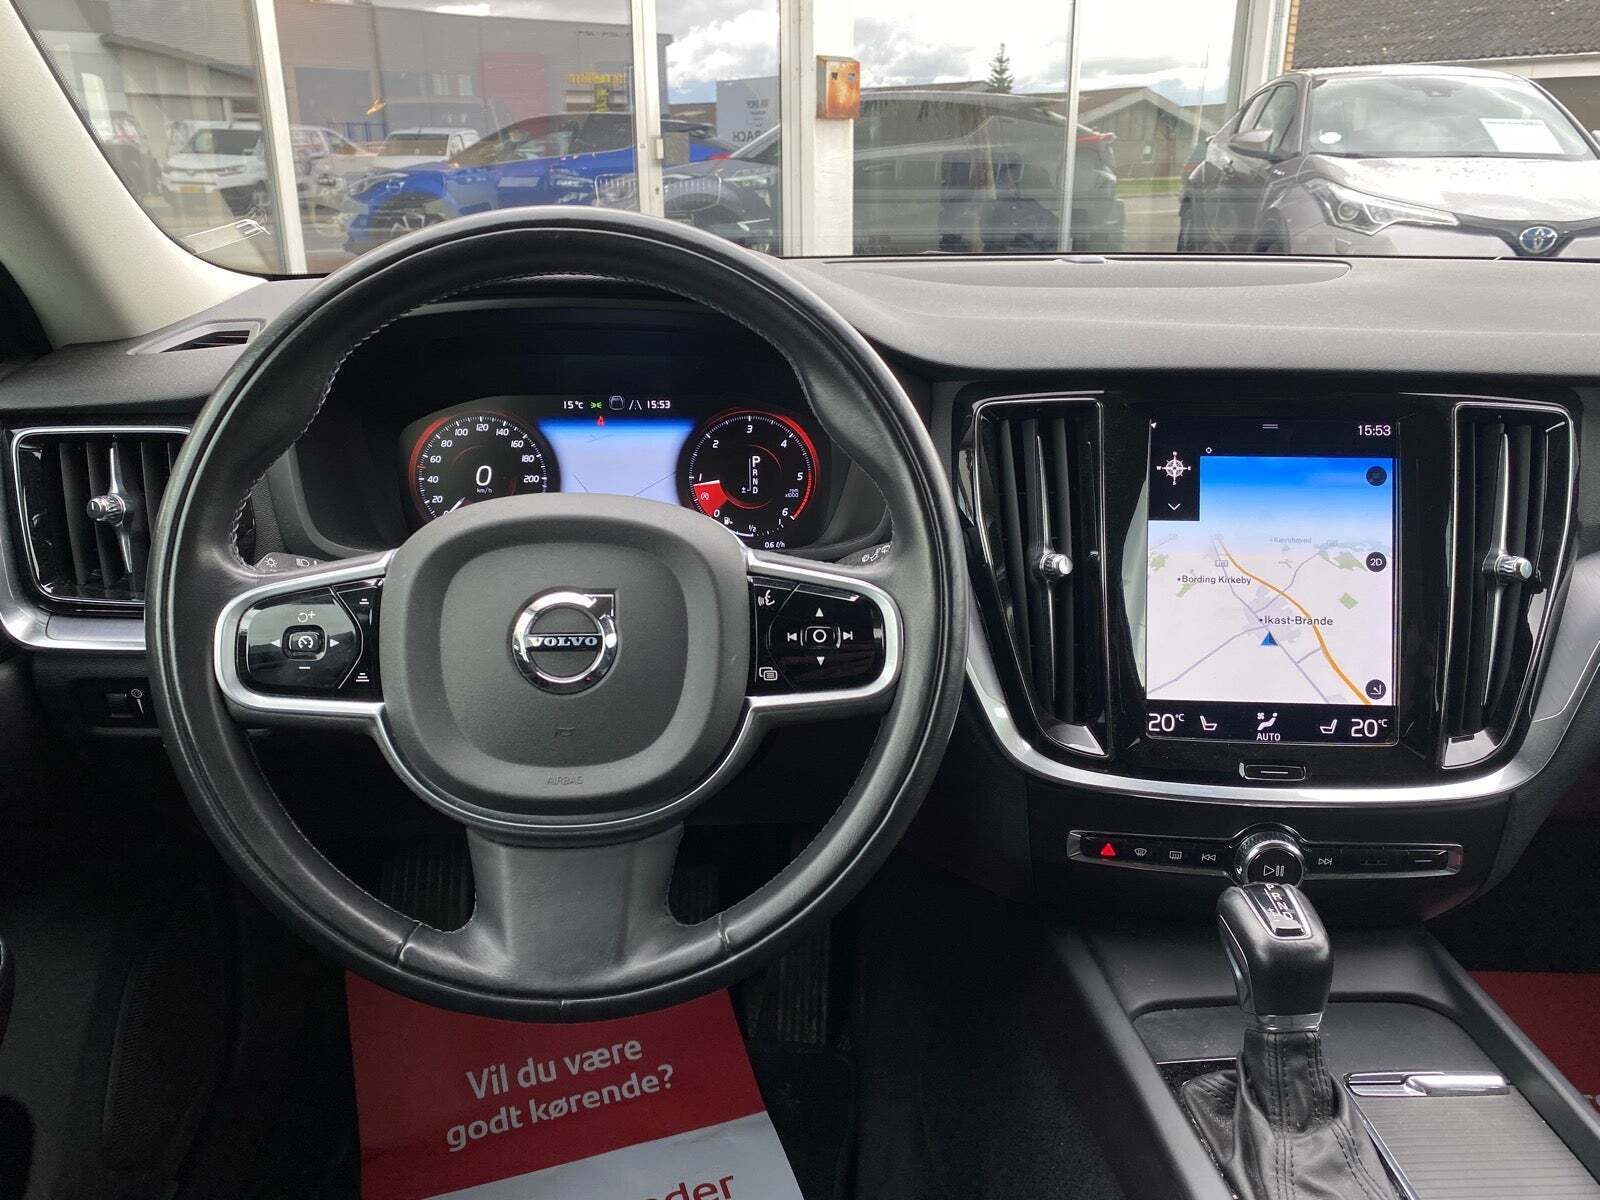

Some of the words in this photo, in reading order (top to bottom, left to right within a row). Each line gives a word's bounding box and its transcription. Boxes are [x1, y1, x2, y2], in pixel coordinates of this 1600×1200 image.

[647, 400, 671, 409] 15:53
[454, 428, 468, 436] 100
[476, 423, 489, 432] 120
[495, 428, 509, 437] 140
[746, 424, 753, 434] 3
[1358, 424, 1392, 437] 15:53
[441, 439, 452, 448] 80
[510, 440, 524, 449] 160
[712, 439, 720, 449] 2
[780, 439, 788, 449] 4
[430, 455, 441, 463] 60
[521, 454, 534, 463] 180
[752, 455, 761, 468] P
[476, 465, 492, 486] 0
[752, 468, 758, 477] R
[797, 471, 804, 481] 5
[427, 475, 439, 484] 40
[523, 475, 539, 483] 200
[752, 477, 759, 486] N
[476, 487, 493, 495] km/h
[752, 486, 759, 494] D
[431, 495, 443, 504] 20
[713, 508, 720, 518] 0
[781, 507, 789, 517] 6
[1369, 557, 1383, 567] 2D
[1181, 575, 1216, 585] Bording
[1218, 576, 1252, 586] Kirkeby
[1264, 615, 1334, 626] Ikast-Brande
[529, 636, 598, 647] VOLVO
[1148, 713, 1184, 732] 20°C
[1350, 718, 1388, 738] 20°C
[1256, 732, 1281, 742] AUTO
[466, 1064, 509, 1100] Vil
[517, 1057, 557, 1089] du
[563, 1039, 643, 1076] være
[446, 1105, 524, 1152] godt
[528, 1063, 674, 1124] kørende?
